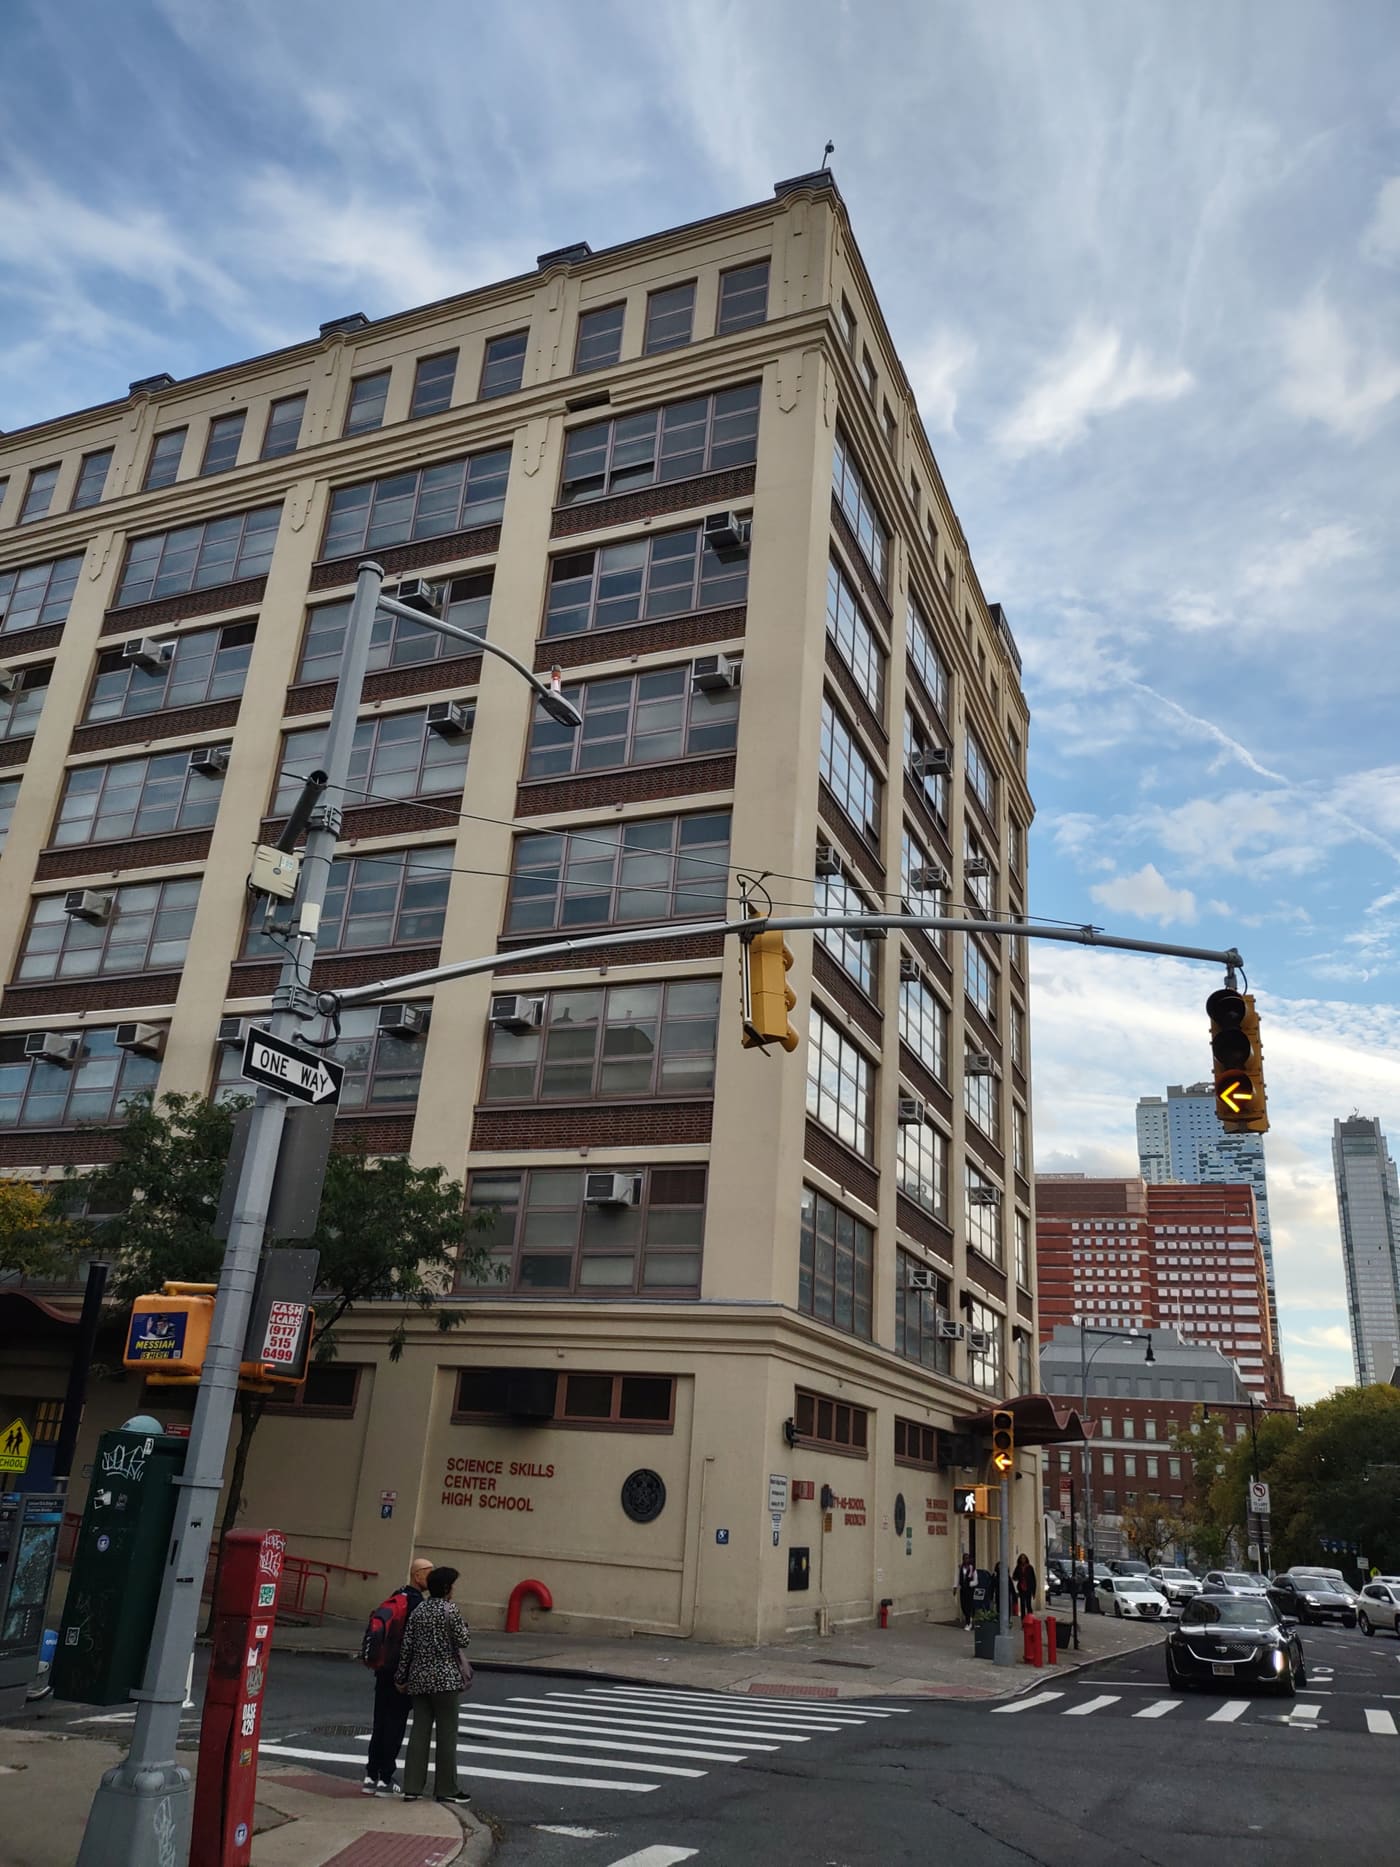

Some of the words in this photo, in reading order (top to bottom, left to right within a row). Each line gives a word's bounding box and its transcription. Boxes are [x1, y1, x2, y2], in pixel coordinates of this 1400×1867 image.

[260, 1049, 290, 1078] ONE
[300, 1066, 329, 1093] WAY
[269, 1325, 296, 1337] (917)
[136, 1340, 176, 1350] MESSIAH
[270, 1336, 291, 1348] 515
[263, 1347, 293, 1361] 6499
[0, 1457, 24, 1468] CHOOL
[446, 1457, 504, 1474] SCIENCE
[509, 1462, 554, 1478] SKILLS
[444, 1474, 497, 1491] CENTER
[441, 1491, 473, 1506] HIGH
[479, 1494, 534, 1512] SCHOOL
